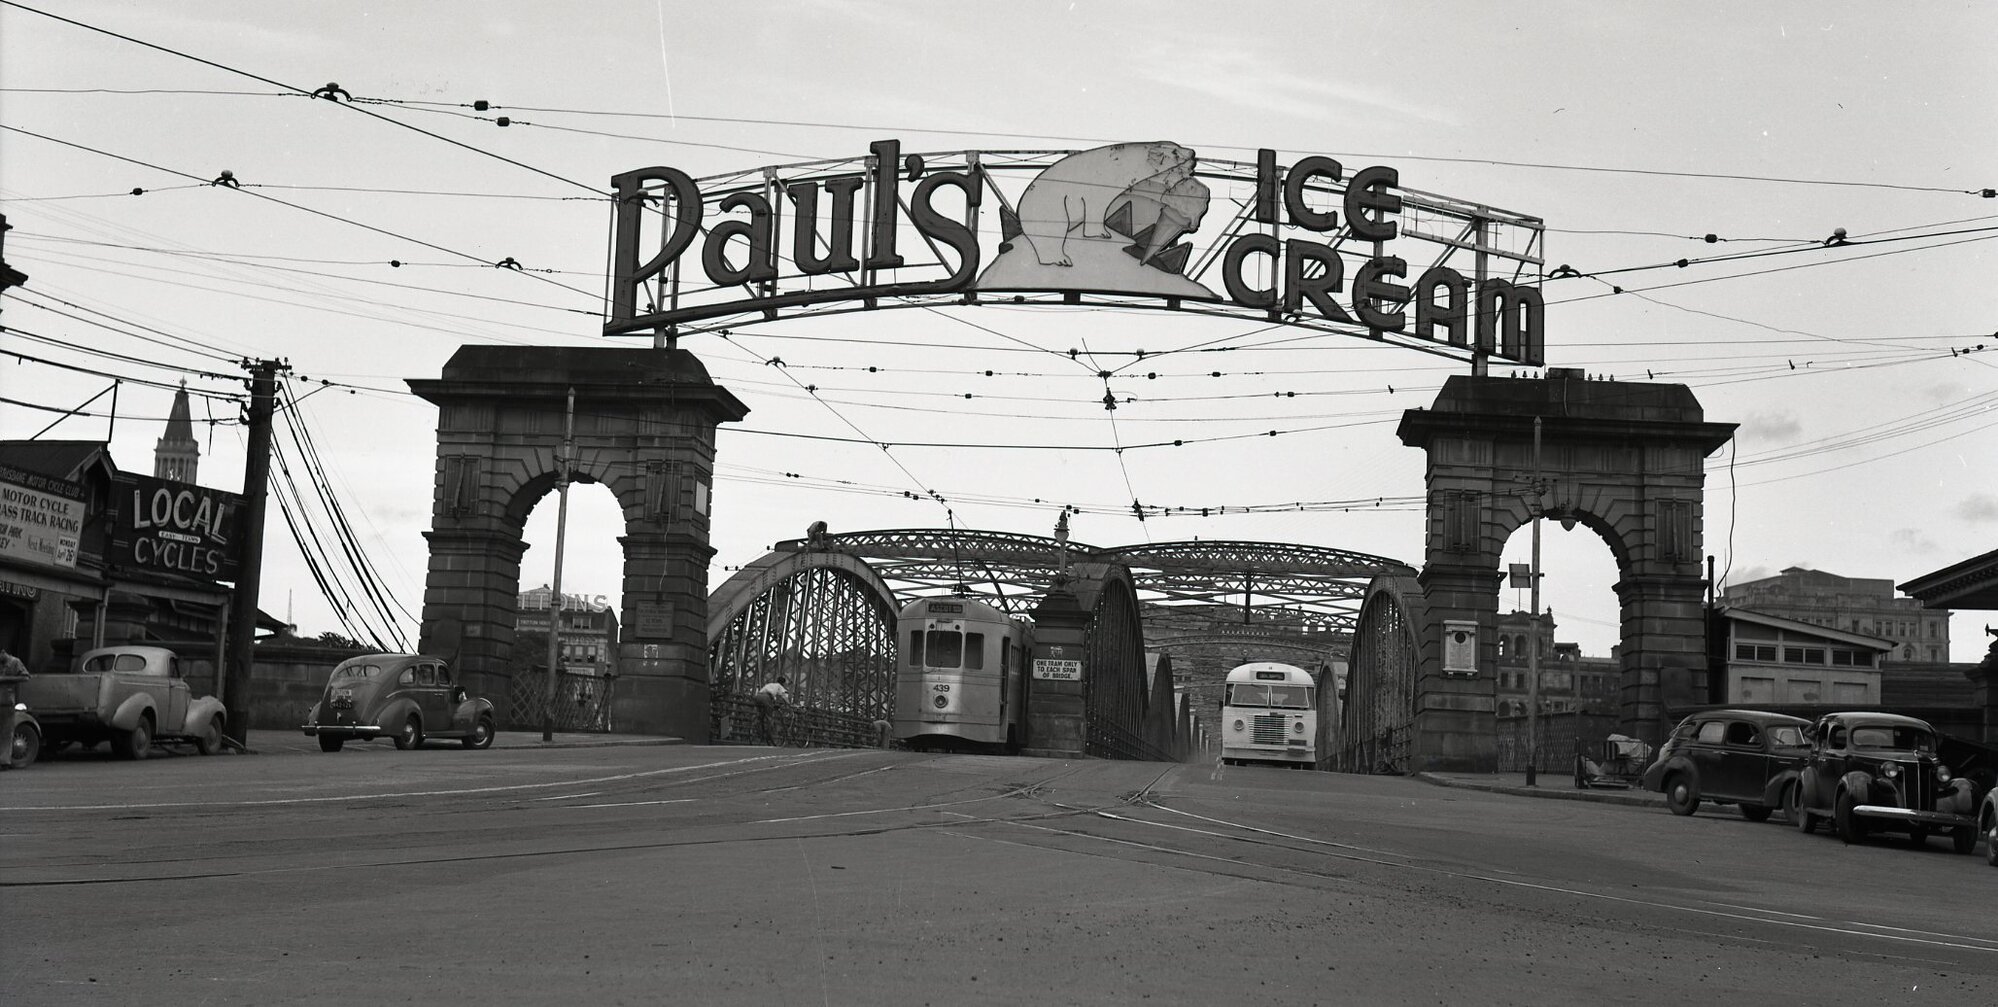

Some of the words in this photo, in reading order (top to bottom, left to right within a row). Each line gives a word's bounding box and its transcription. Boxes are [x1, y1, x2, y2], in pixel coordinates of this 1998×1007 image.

[1256, 148, 1401, 242] ICE
[603, 139, 982, 336] Paul's
[1222, 233, 1546, 366] CREAM
[2, 487, 37, 507] MOTOR
[39, 497, 69, 514] CYCLE
[48, 480, 64, 494] CYCLE
[65, 485, 80, 498] CLUB
[0, 503, 18, 519] ASS
[20, 508, 47, 526] TRACK
[50, 516, 79, 533] RACING
[133, 488, 229, 546] LOCAL
[59, 539, 76, 549] MONDAY
[134, 537, 220, 575] CYCLES
[933, 684, 950, 692] 439
